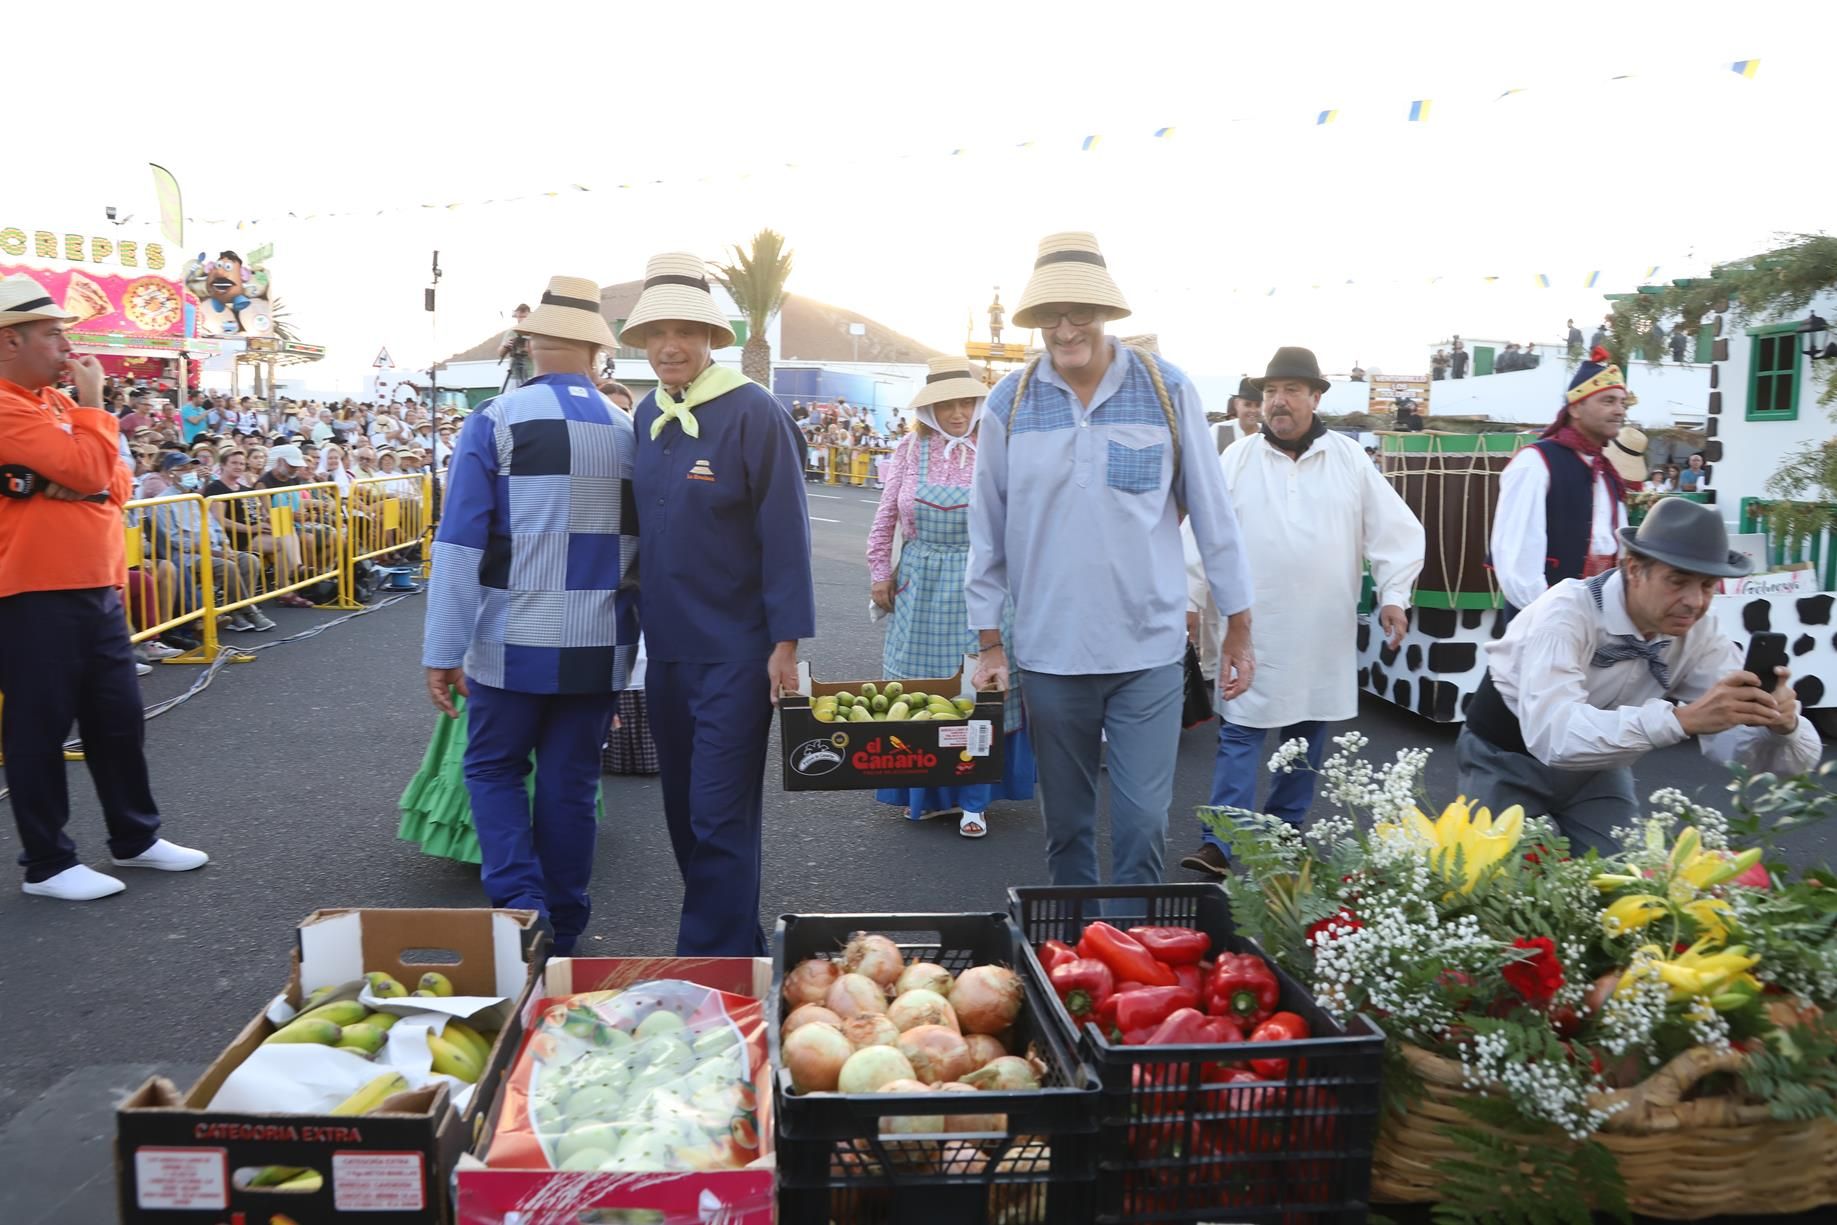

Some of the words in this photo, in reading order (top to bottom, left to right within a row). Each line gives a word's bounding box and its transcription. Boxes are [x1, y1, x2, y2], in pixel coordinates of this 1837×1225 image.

[0, 227, 166, 270] CREPES
[865, 737, 881, 753] el
[851, 749, 937, 769] Canario
[194, 1122, 299, 1141] CATEGORIA
[301, 1126, 363, 1143] EXTRA
